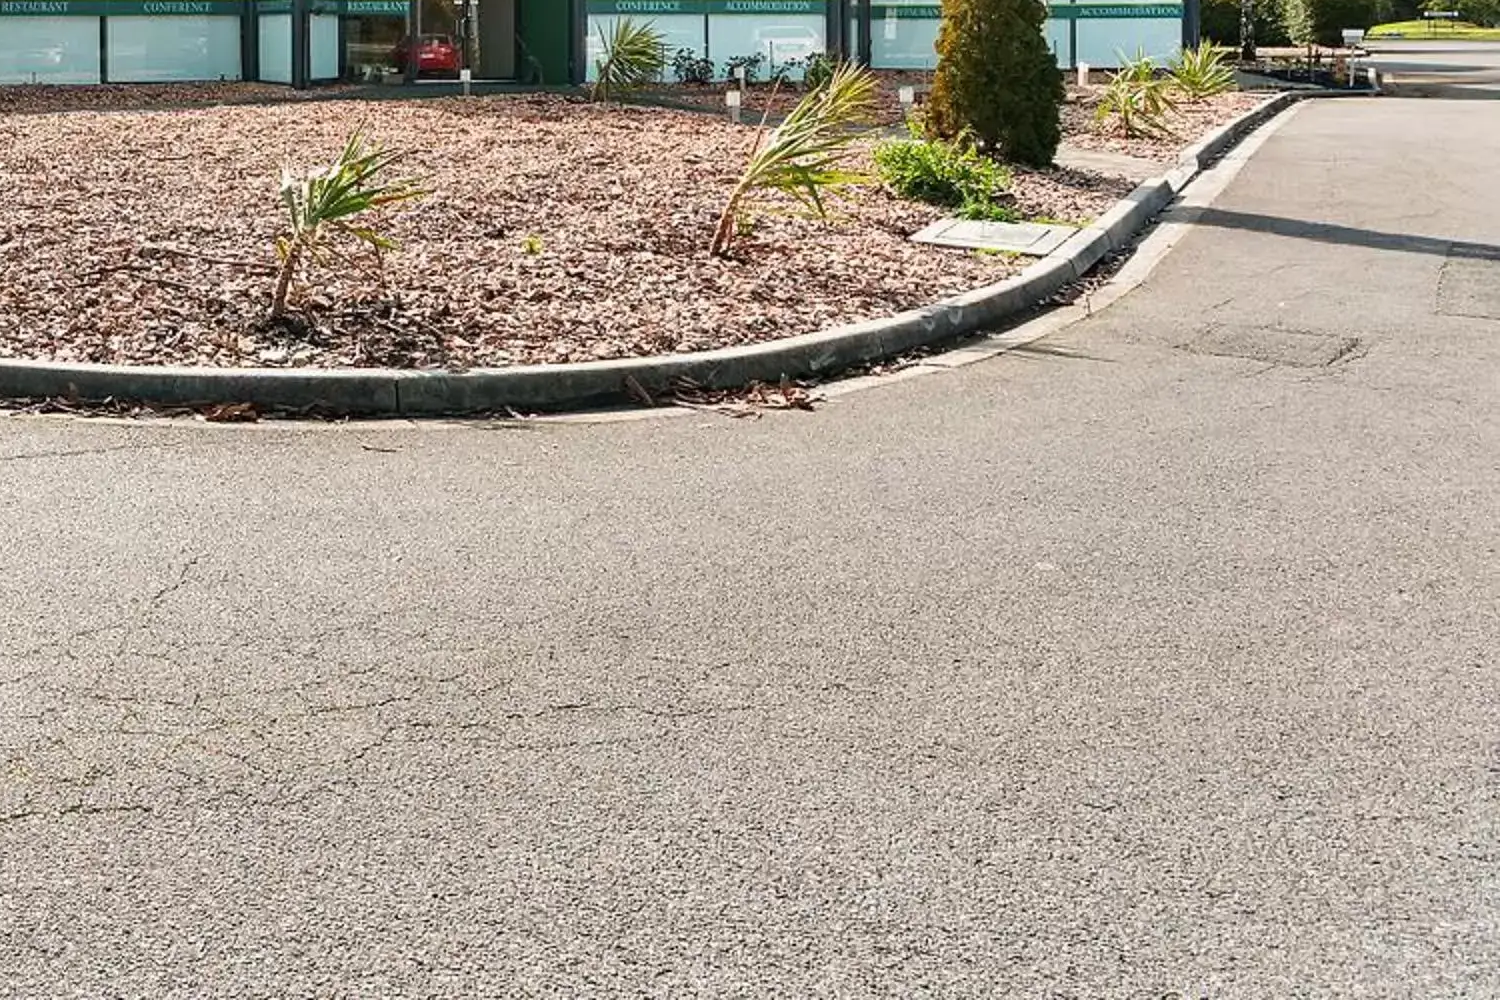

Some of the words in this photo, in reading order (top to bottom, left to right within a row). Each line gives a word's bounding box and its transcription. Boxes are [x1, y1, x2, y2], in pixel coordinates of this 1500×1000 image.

[1, 1, 69, 13] RESTAURANT
[143, 1, 213, 13] CONFERENCE
[347, 1, 411, 12] RESTAURANT
[615, 0, 681, 11] CONFERENCE
[724, 0, 810, 11] ACCOMMODATION
[1079, 7, 1182, 17] ACCOMMODATION
